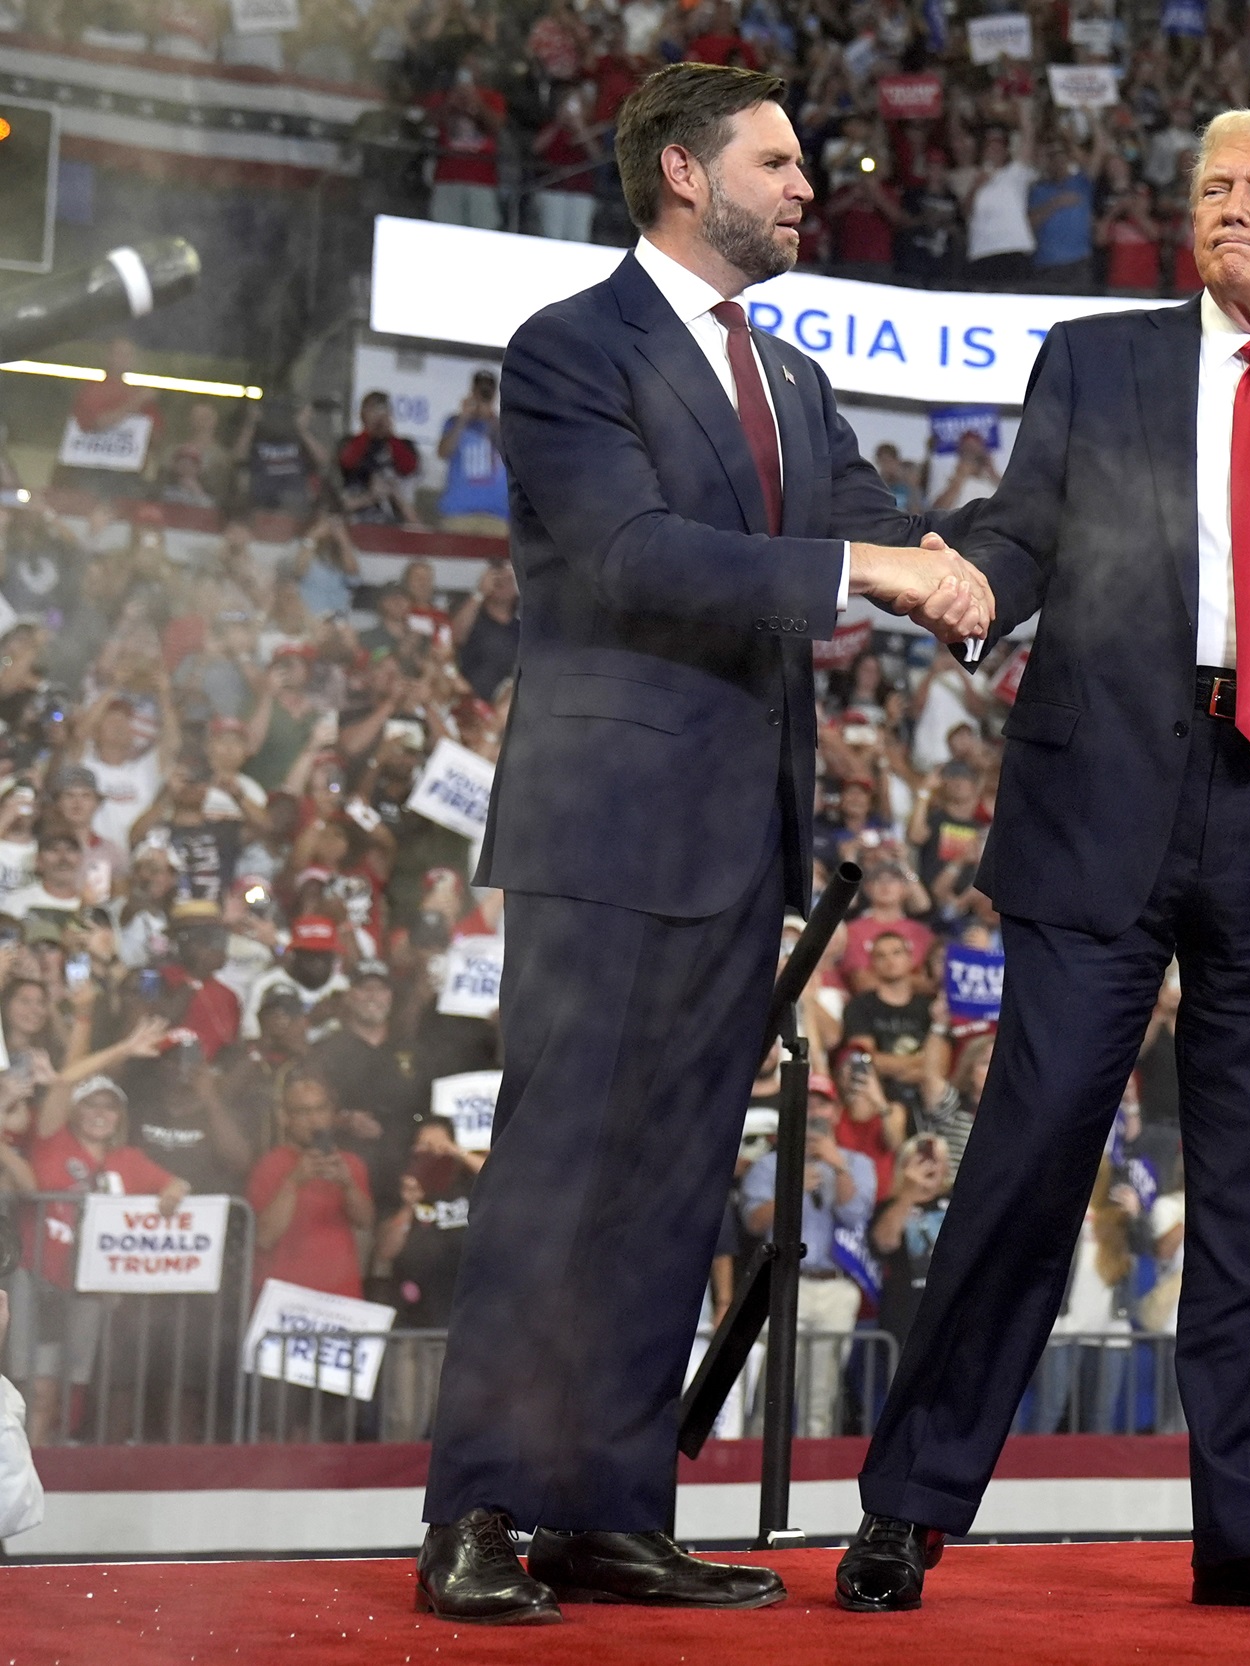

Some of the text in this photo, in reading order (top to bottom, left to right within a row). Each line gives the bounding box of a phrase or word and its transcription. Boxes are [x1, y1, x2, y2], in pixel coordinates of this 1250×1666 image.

[940, 326, 996, 368] IS
[124, 1211, 192, 1231] VOTE
[99, 1233, 211, 1252] DONALD
[108, 1254, 202, 1275] TRUMP
